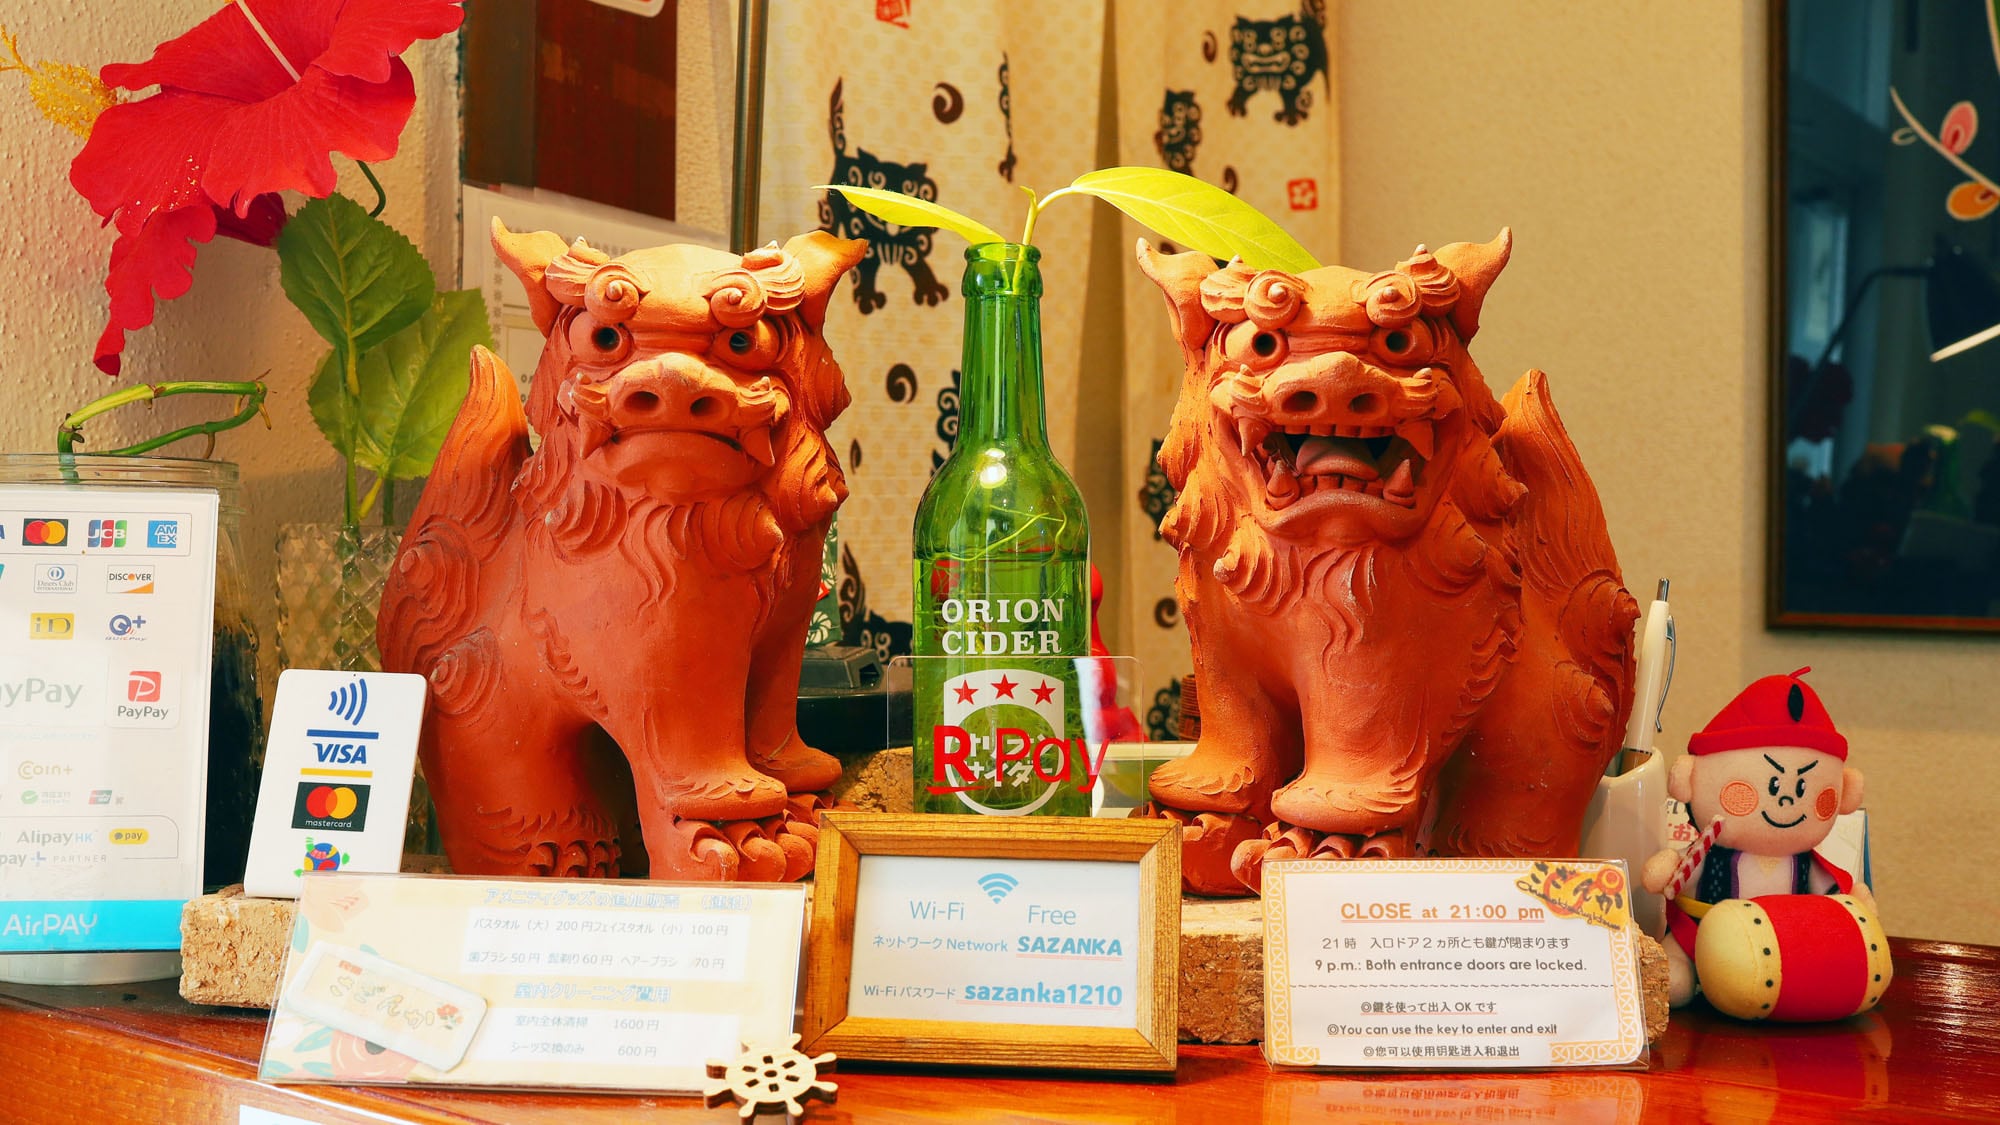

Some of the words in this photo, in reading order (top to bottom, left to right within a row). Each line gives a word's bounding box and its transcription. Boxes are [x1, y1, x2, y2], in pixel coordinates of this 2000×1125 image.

[88, 524, 127, 543] JCB
[941, 598, 1065, 623] ORION
[35, 616, 71, 634] iD
[941, 630, 1062, 655] CIDER
[117, 705, 169, 720] PayPay
[312, 742, 367, 764] VISA
[305, 819, 352, 828] mastercard
[125, 831, 143, 841] pay
[53, 855, 107, 864] PARTNER
[909, 900, 965, 921] Wi-Fi
[1028, 905, 1076, 925] Free
[1340, 902, 1412, 920] CLOSE
[1421, 905, 1438, 919] at
[1450, 904, 1507, 920] 21:00
[1518, 906, 1545, 921] pm
[3, 913, 98, 936] AirPAY
[872, 934, 942, 949] ネットワーク
[947, 937, 1008, 952] Network
[1017, 936, 1123, 956] SAZANKA
[1315, 960, 1322, 971] 9
[1366, 959, 1396, 971] Both
[1400, 960, 1463, 971] entrance
[1467, 959, 1505, 971] doors
[1509, 961, 1532, 971] are
[1536, 959, 1588, 971] locked.
[863, 984, 897, 997] Wi-Fi
[900, 985, 956, 999] パスワード
[964, 982, 1123, 1006] sazanka1210
[1366, 1026, 1388, 1035] can
[1392, 1026, 1411, 1035] use
[1415, 1024, 1433, 1034] the
[1437, 1024, 1458, 1037] key
[1462, 1025, 1473, 1034] to
[1477, 1025, 1506, 1034] enter
[1511, 1024, 1533, 1034] and
[1537, 1024, 1557, 1034] exit
